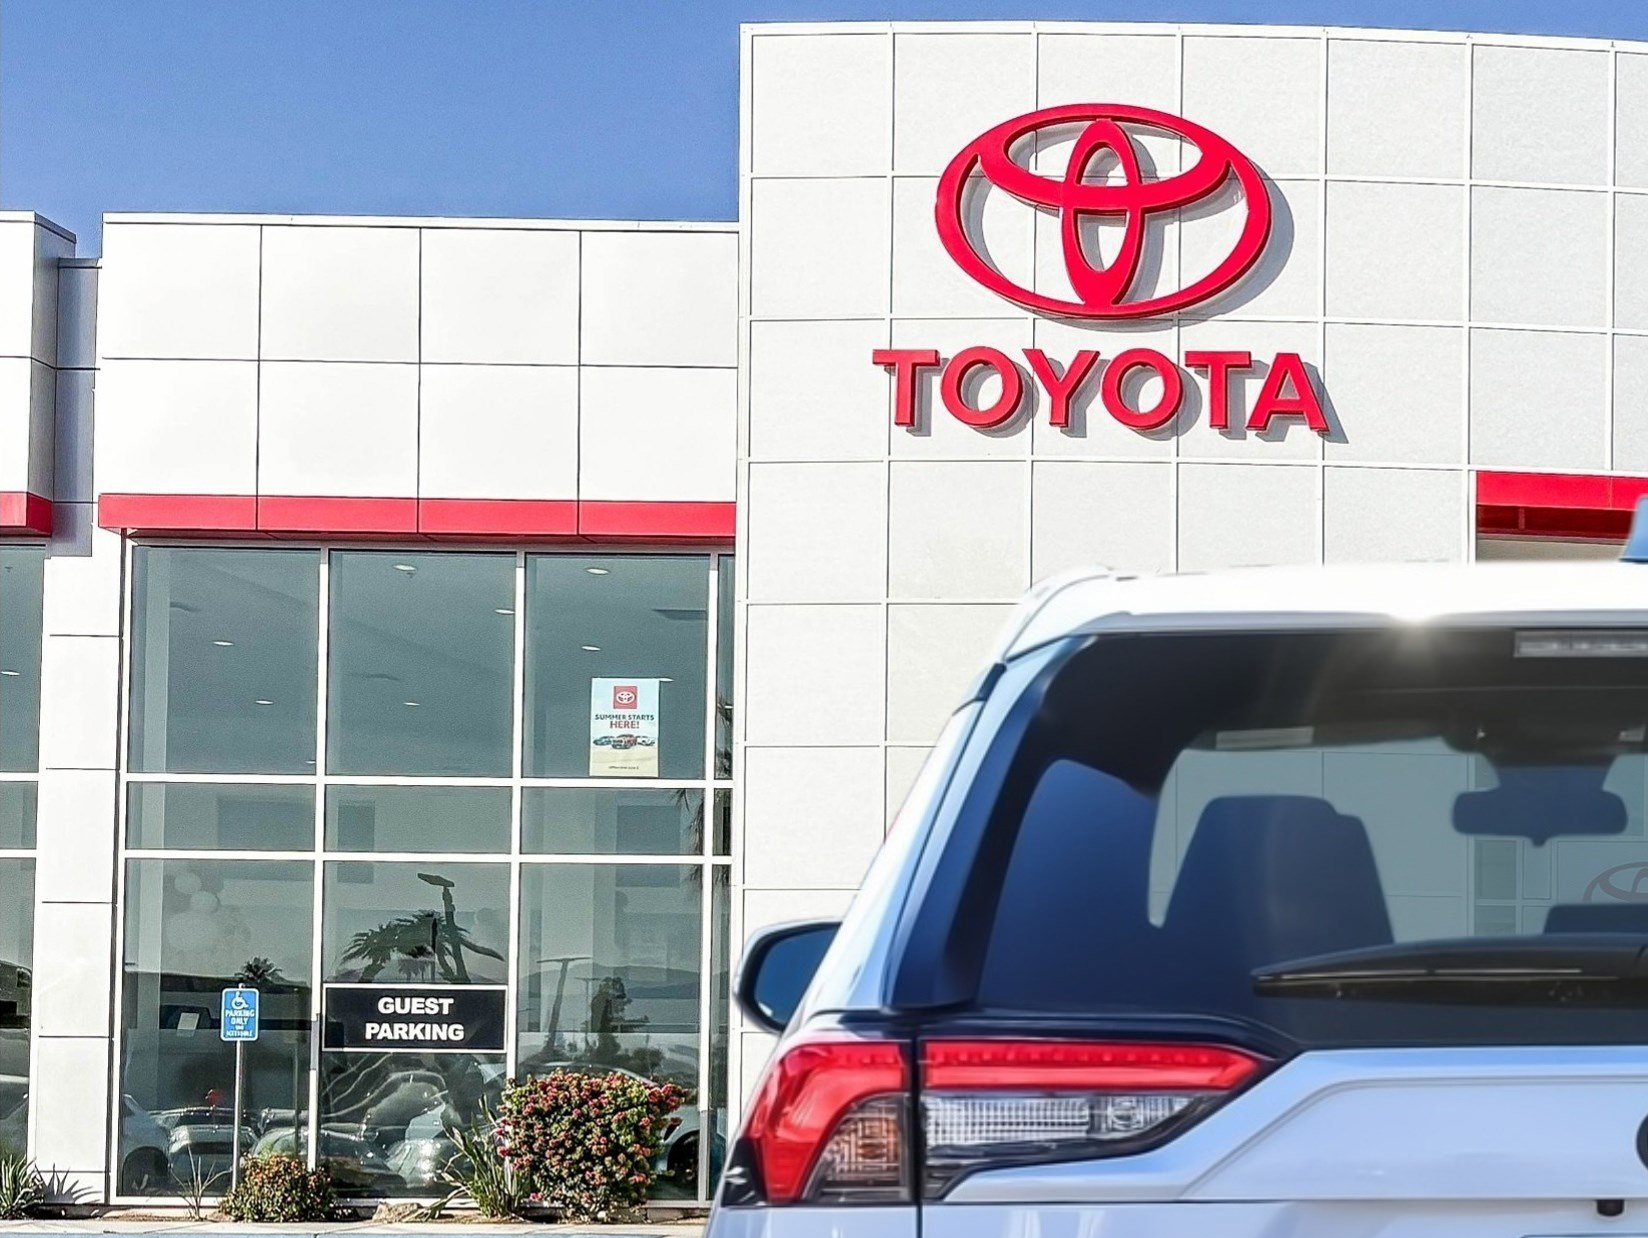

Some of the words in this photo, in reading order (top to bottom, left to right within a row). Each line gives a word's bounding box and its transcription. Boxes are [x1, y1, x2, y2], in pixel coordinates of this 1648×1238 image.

[872, 346, 1328, 431] TOYOTA
[610, 720, 640, 729] HERE!
[377, 997, 454, 1015] GUEST
[365, 1023, 464, 1041] PARKING
